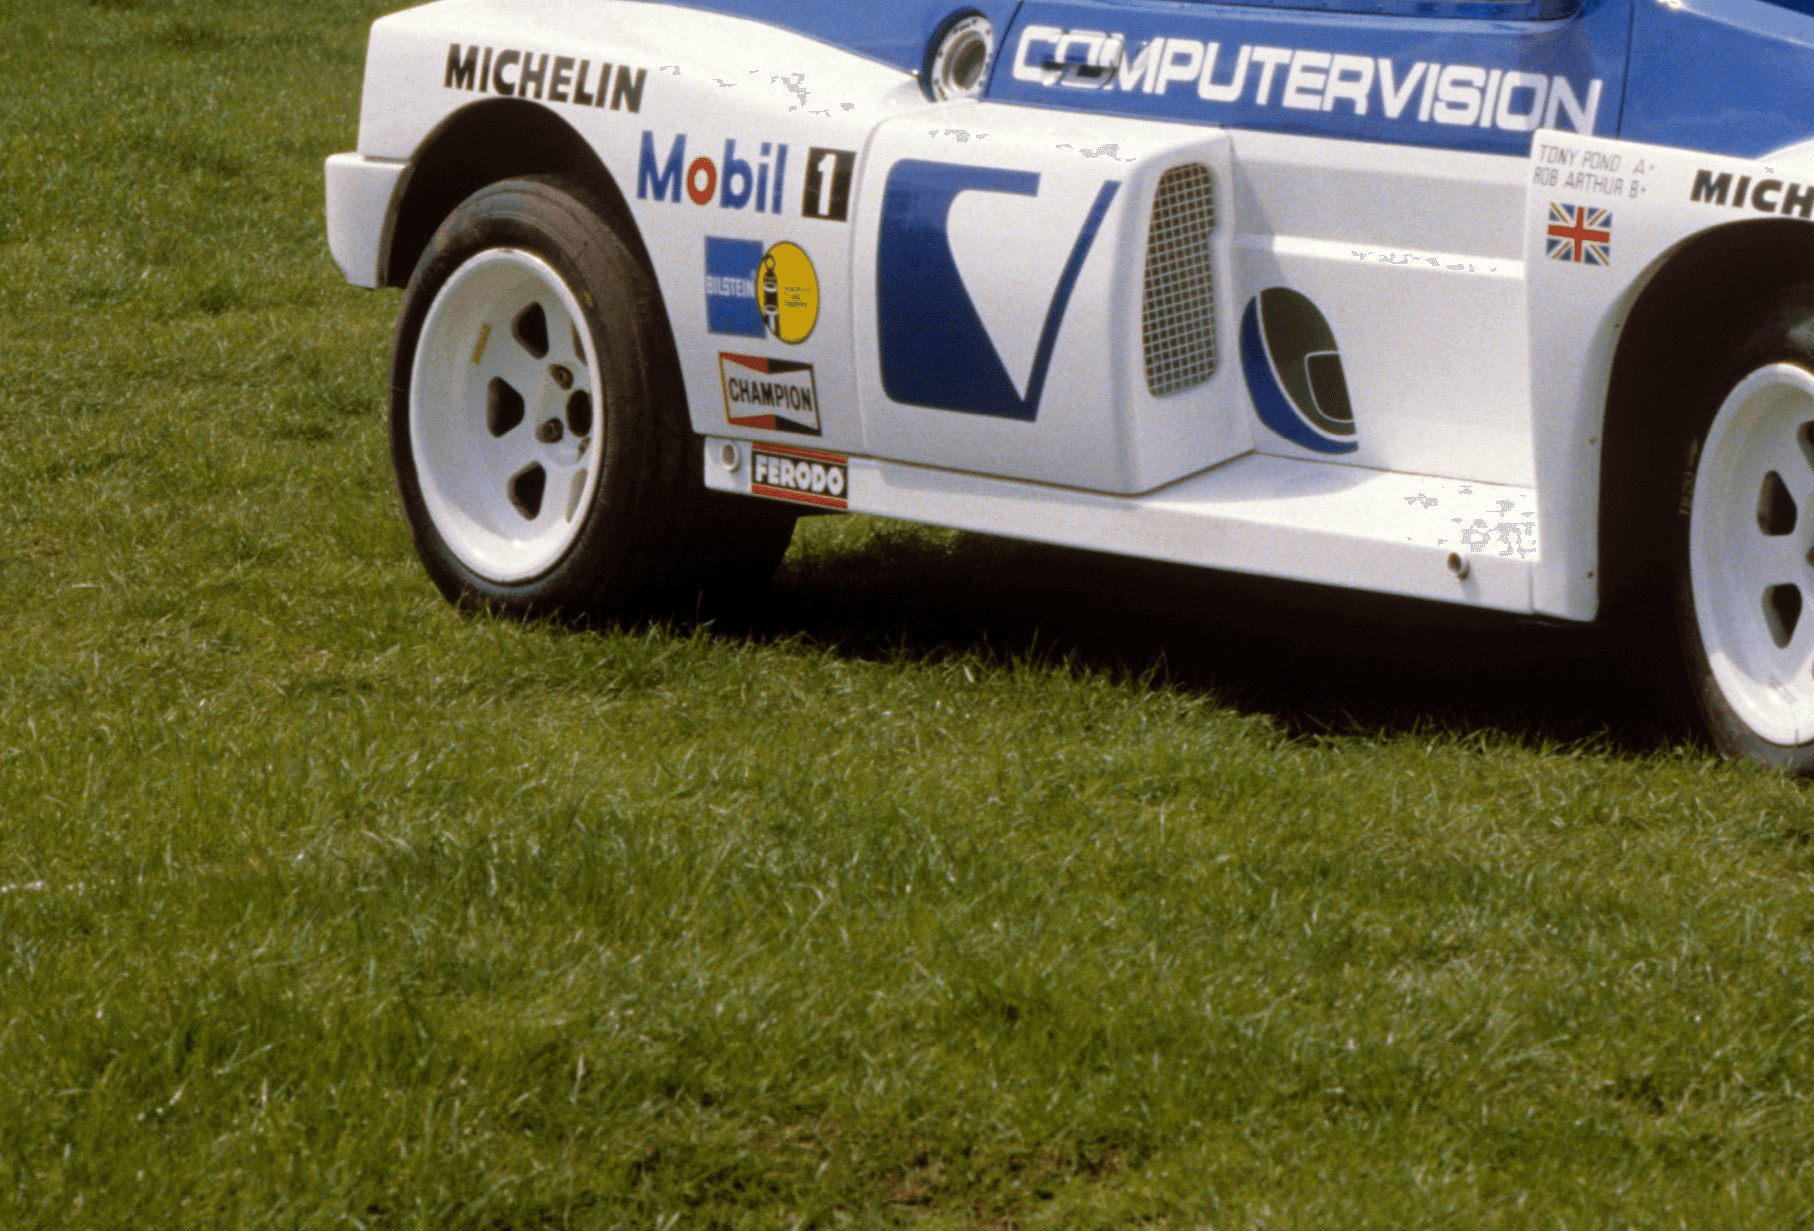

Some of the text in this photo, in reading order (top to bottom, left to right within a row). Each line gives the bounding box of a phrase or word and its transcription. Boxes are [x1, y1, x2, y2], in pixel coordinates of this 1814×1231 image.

[444, 43, 647, 113] MICHELIN
[1012, 25, 1603, 135] COMPUTERVISION
[637, 130, 788, 214] Mobil
[1541, 144, 1579, 166] TONY
[1581, 151, 1621, 172] POND
[1564, 171, 1624, 196] ARTHUR
[706, 275, 756, 298] BILSTEIN
[728, 377, 812, 412] CHAMPION
[755, 454, 844, 495] FERODO
